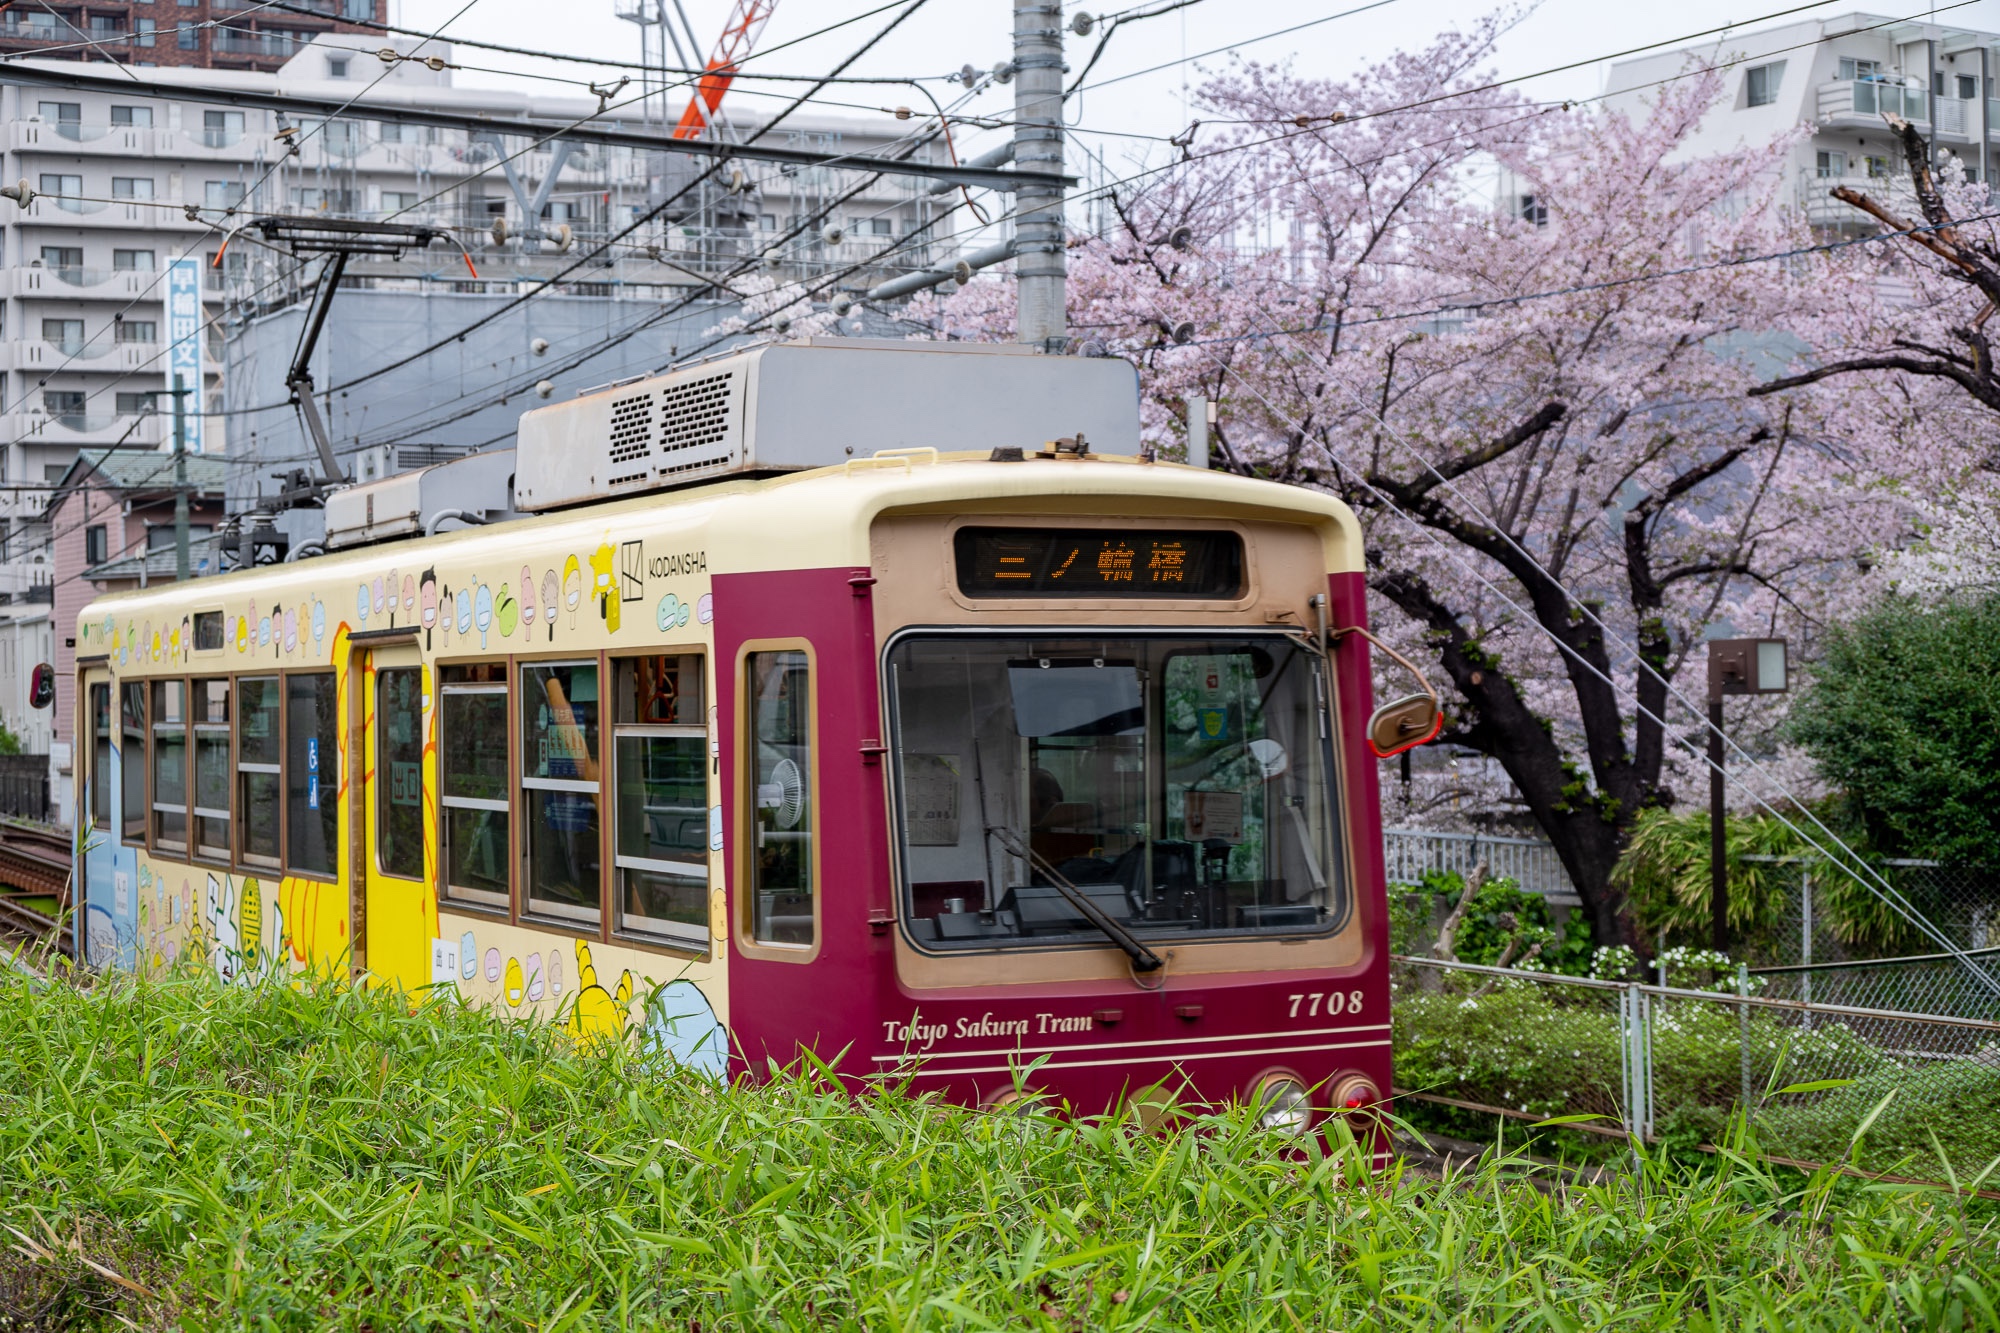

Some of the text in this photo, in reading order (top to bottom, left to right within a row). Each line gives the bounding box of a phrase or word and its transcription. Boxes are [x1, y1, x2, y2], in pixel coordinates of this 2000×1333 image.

[172, 267, 199, 452] 早稲田文理
[649, 551, 708, 579] KODANSHA
[994, 541, 1187, 582] 三ノ輪橋
[1288, 990, 1364, 1018] 7708
[882, 1011, 1093, 1050] Tokyo Sakura Tram
